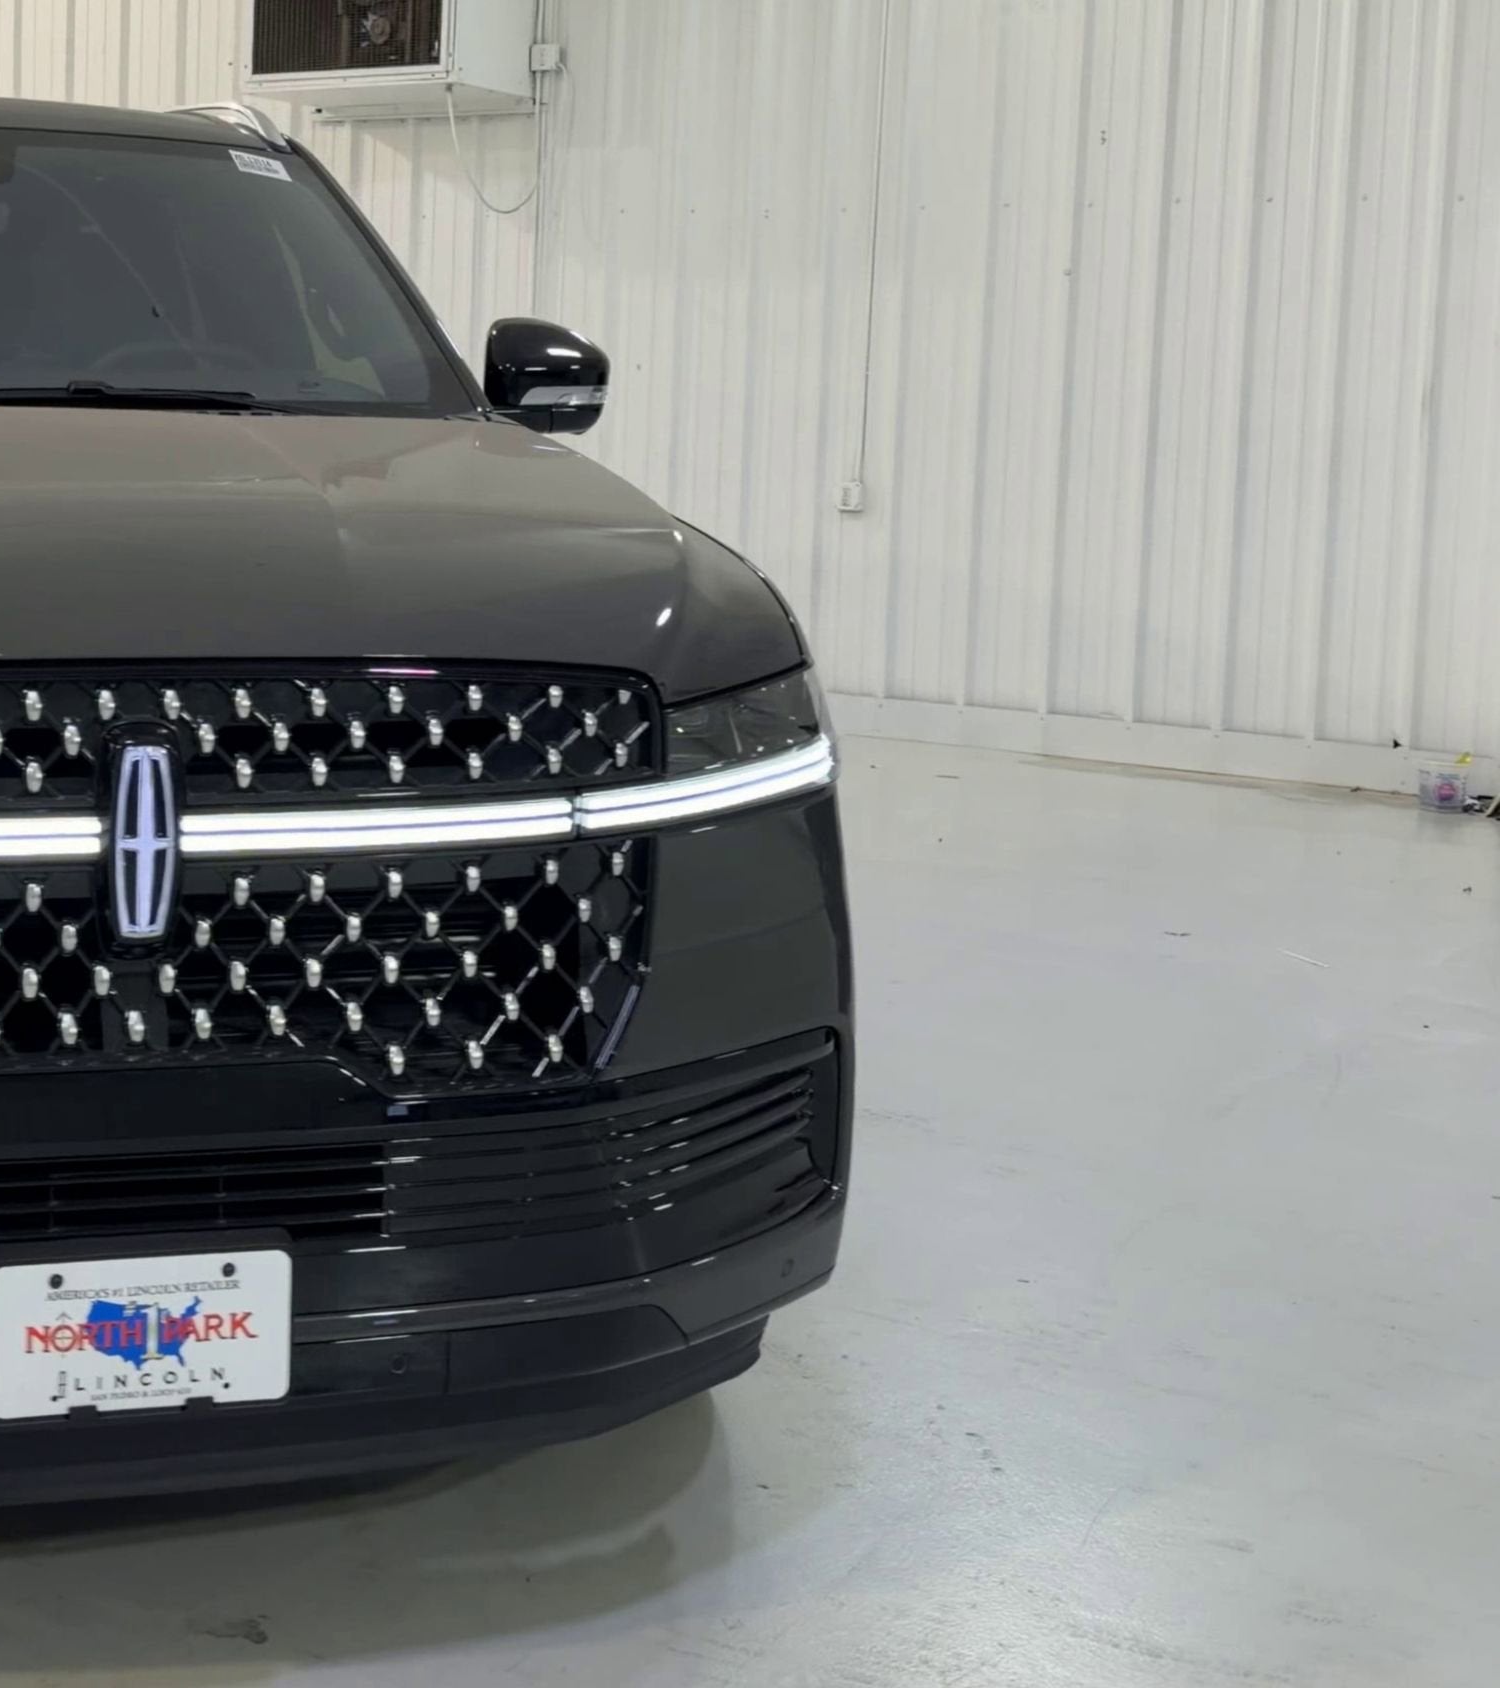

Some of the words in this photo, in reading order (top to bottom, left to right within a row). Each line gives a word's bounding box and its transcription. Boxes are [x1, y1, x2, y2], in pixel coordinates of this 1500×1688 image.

[126, 1283, 181, 1297] LINCOLN
[184, 1279, 240, 1293] RETAILER
[25, 1319, 143, 1354] NORTH
[163, 1312, 258, 1344] PARK
[74, 1367, 226, 1391] LINCOLN
